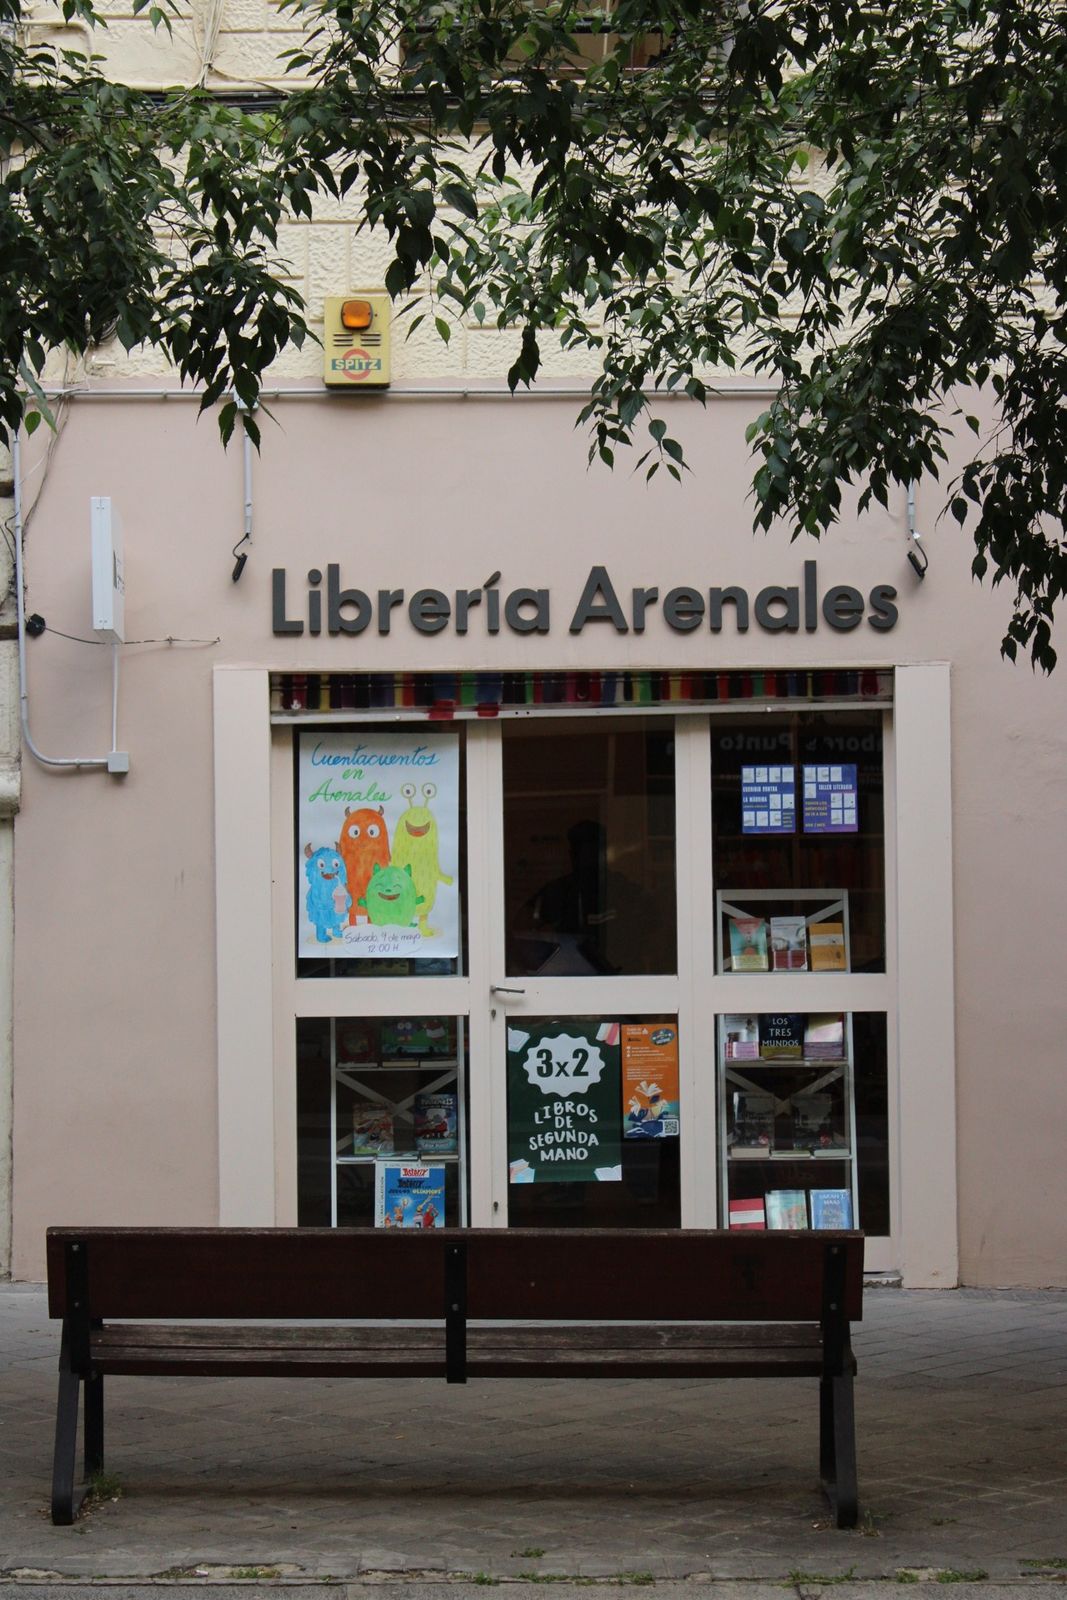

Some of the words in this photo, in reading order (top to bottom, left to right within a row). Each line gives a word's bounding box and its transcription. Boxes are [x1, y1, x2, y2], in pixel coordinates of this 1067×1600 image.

[335, 359, 378, 370] SPITZ
[271, 562, 551, 636] Librería
[569, 560, 899, 635] Arenales
[311, 742, 441, 767] Cuentacuentos
[342, 768, 365, 780] en
[308, 778, 393, 802] Arenales
[401, 933, 421, 944] mayo
[772, 1017, 788, 1025] LOS
[769, 1028, 792, 1037] TRES
[762, 1039, 799, 1047] MUNDOS
[536, 1048, 589, 1078] 3x2
[534, 1101, 598, 1124] LIBROS
[555, 1116, 573, 1128] DE
[529, 1129, 599, 1150] SEGUNDA
[540, 1147, 588, 1162] MANO
